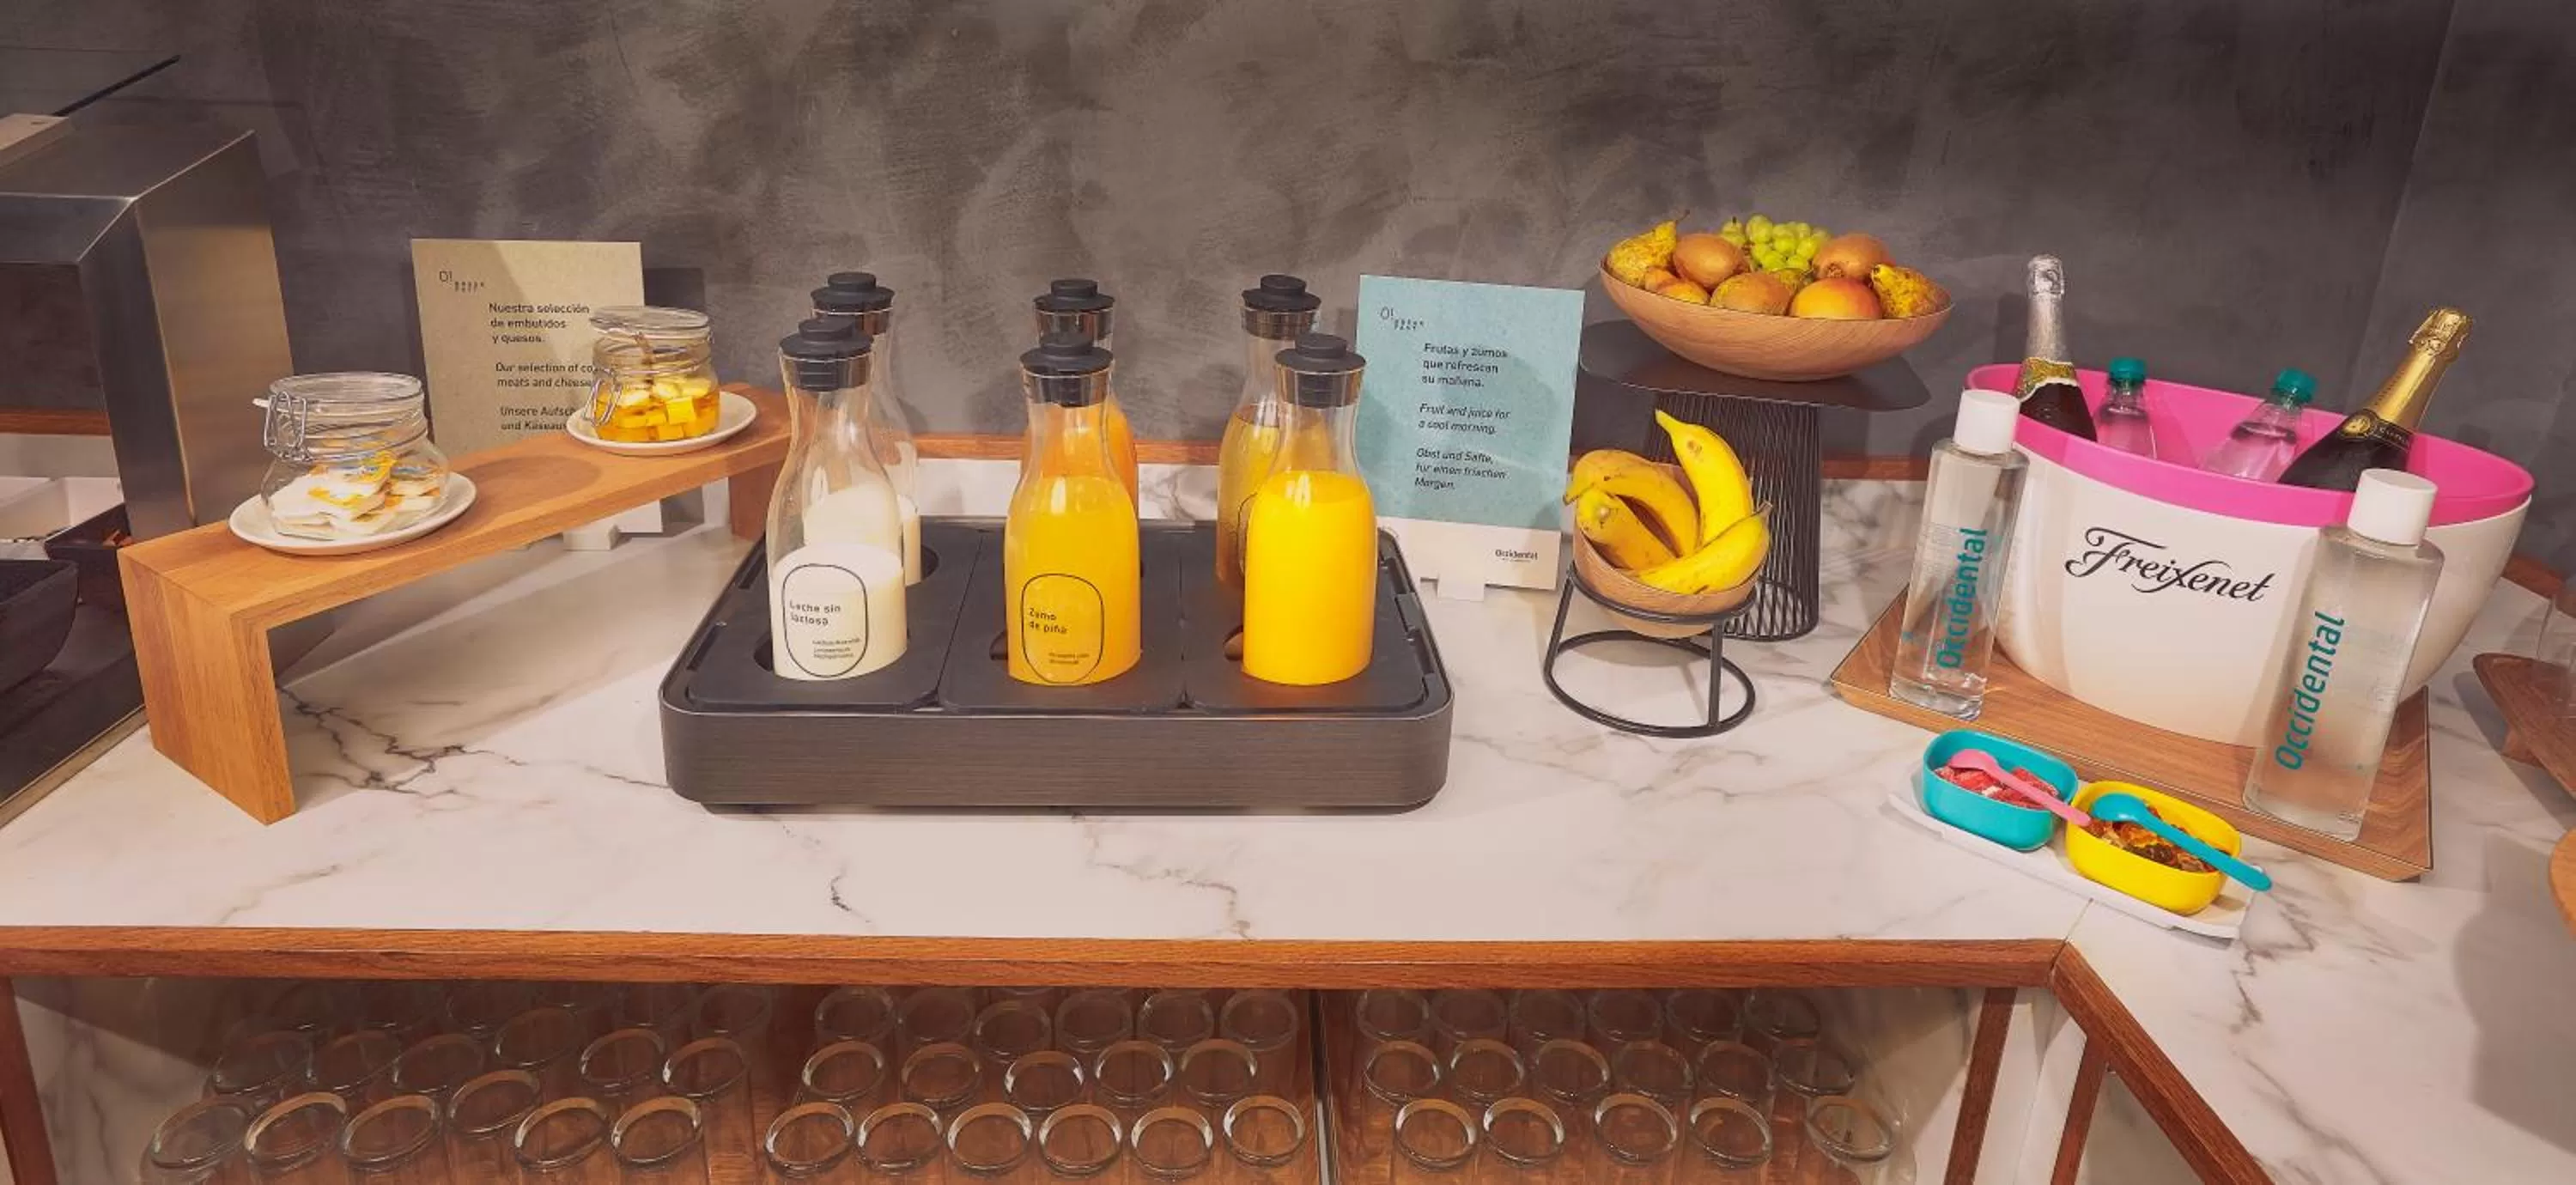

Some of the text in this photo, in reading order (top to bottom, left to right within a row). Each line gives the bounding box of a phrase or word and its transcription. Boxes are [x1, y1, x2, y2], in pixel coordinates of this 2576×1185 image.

[488, 302, 591, 313] Nuestra selección
[490, 317, 567, 328] de embutidos
[492, 335, 545, 343] y quesos.
[1424, 343, 1509, 358] Frutas y zumos
[495, 362, 515, 372] Our
[518, 362, 566, 372] selection
[568, 363, 579, 373] of
[1423, 360, 1499, 374] que refrescan
[497, 378, 530, 387] meats
[532, 378, 552, 387] and
[1421, 375, 1435, 384] su
[500, 406, 538, 416] Unsere
[1419, 403, 1511, 419] Fruit and juice for
[501, 420, 521, 430] und
[1418, 420, 1425, 428] a
[1427, 421, 1449, 430] cool
[1416, 447, 1440, 459] Obst
[1442, 451, 1464, 461] und
[1433, 465, 1462, 475] einen
[1464, 467, 1508, 479] frischen
[1495, 549, 1539, 561] Occidental
[2064, 526, 2276, 602] Freixenet
[1936, 527, 1988, 669] Occidental
[789, 599, 841, 613] Leche sin
[790, 612, 829, 626] lactosa
[1029, 607, 1057, 621] Zumo
[1030, 621, 1040, 629] de
[2275, 611, 2345, 770] Occidental
